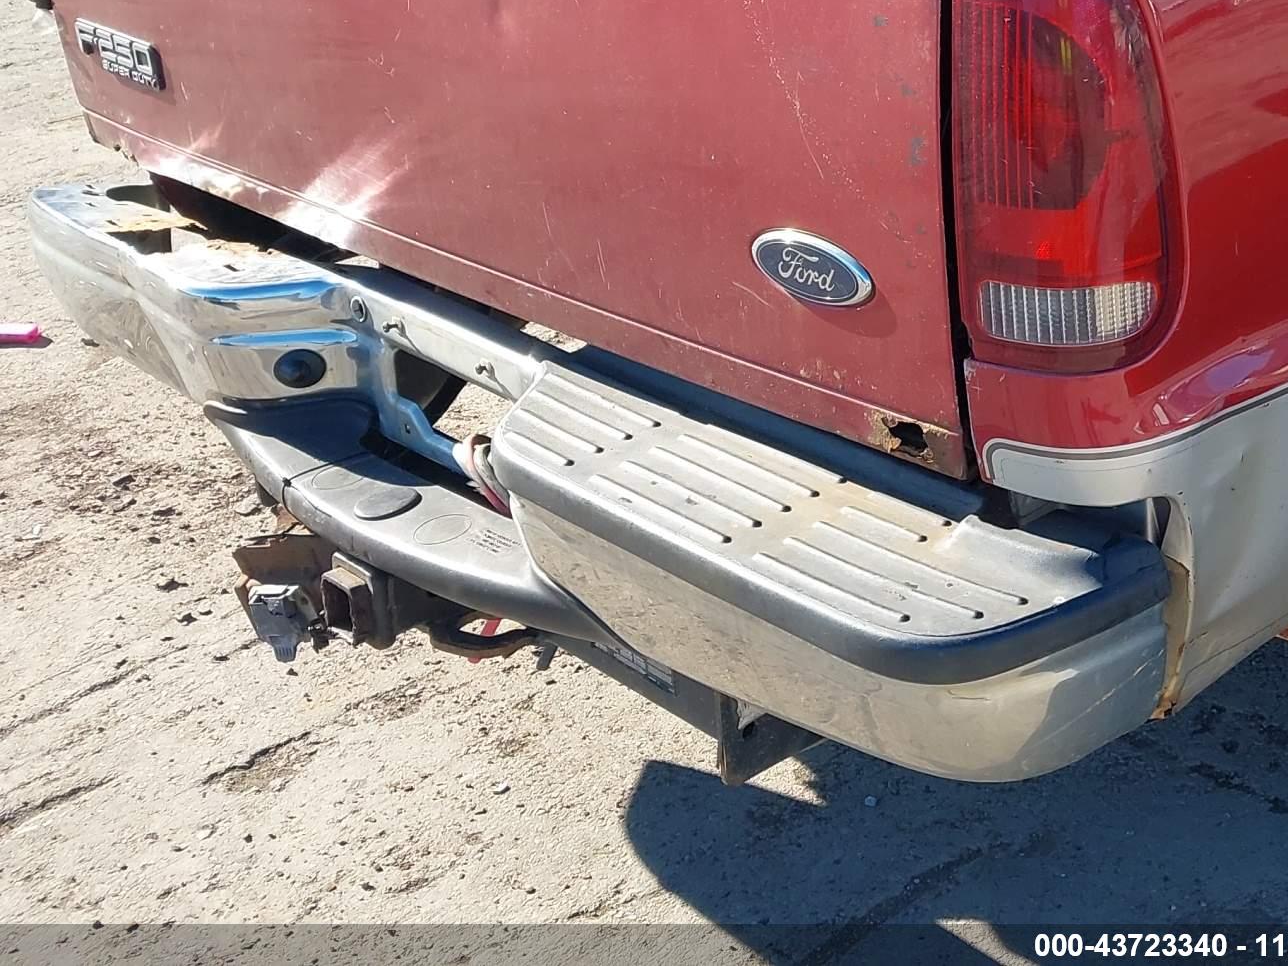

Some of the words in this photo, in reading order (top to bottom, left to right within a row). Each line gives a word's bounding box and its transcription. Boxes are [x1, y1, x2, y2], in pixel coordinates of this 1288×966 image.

[101, 58, 131, 79] SUPER
[131, 70, 158, 90] DUTY
[778, 247, 835, 292] Ford
